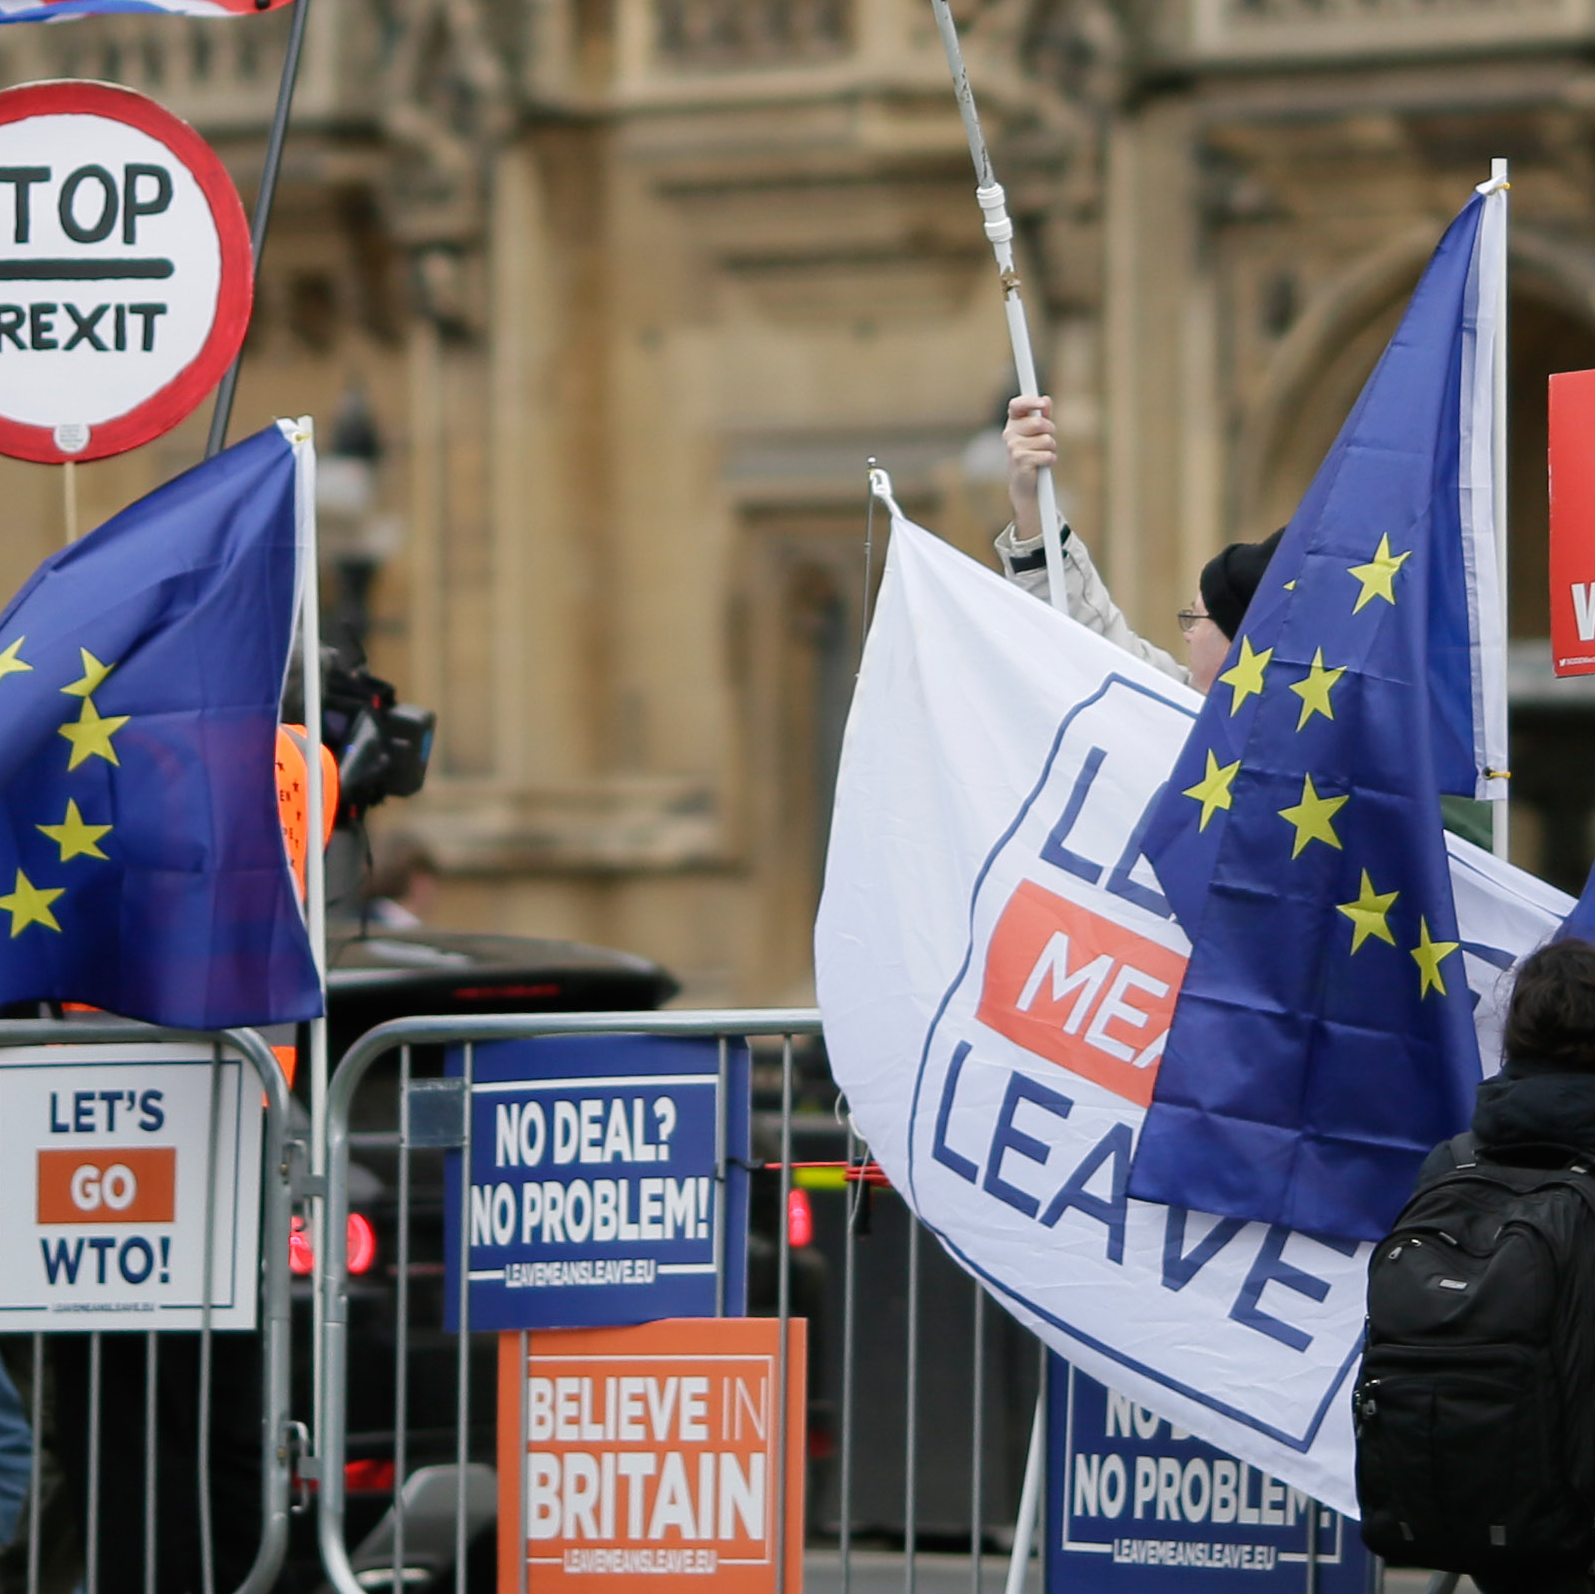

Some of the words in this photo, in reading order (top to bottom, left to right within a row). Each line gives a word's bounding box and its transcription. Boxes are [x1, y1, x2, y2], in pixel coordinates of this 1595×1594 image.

[50, 1089, 165, 1134] LET'S
[495, 1100, 547, 1168] NO
[554, 1096, 678, 1164] DEAL?
[70, 1163, 138, 1212] GO
[471, 1182, 517, 1247] NO
[521, 1177, 710, 1245] PROBLEM!
[932, 1040, 1362, 1353] LEAVE
[40, 1235, 172, 1285] WTO!
[505, 1258, 656, 1289] LEAVEMEANSLEAVE.EU
[527, 1376, 710, 1442] BELIEVE
[722, 1376, 767, 1441] IN
[526, 1452, 766, 1541] BRITAIN
[1073, 1453, 1127, 1519] NO
[1113, 1538, 1276, 1571] LEAVEMEANSLEAVE.EU
